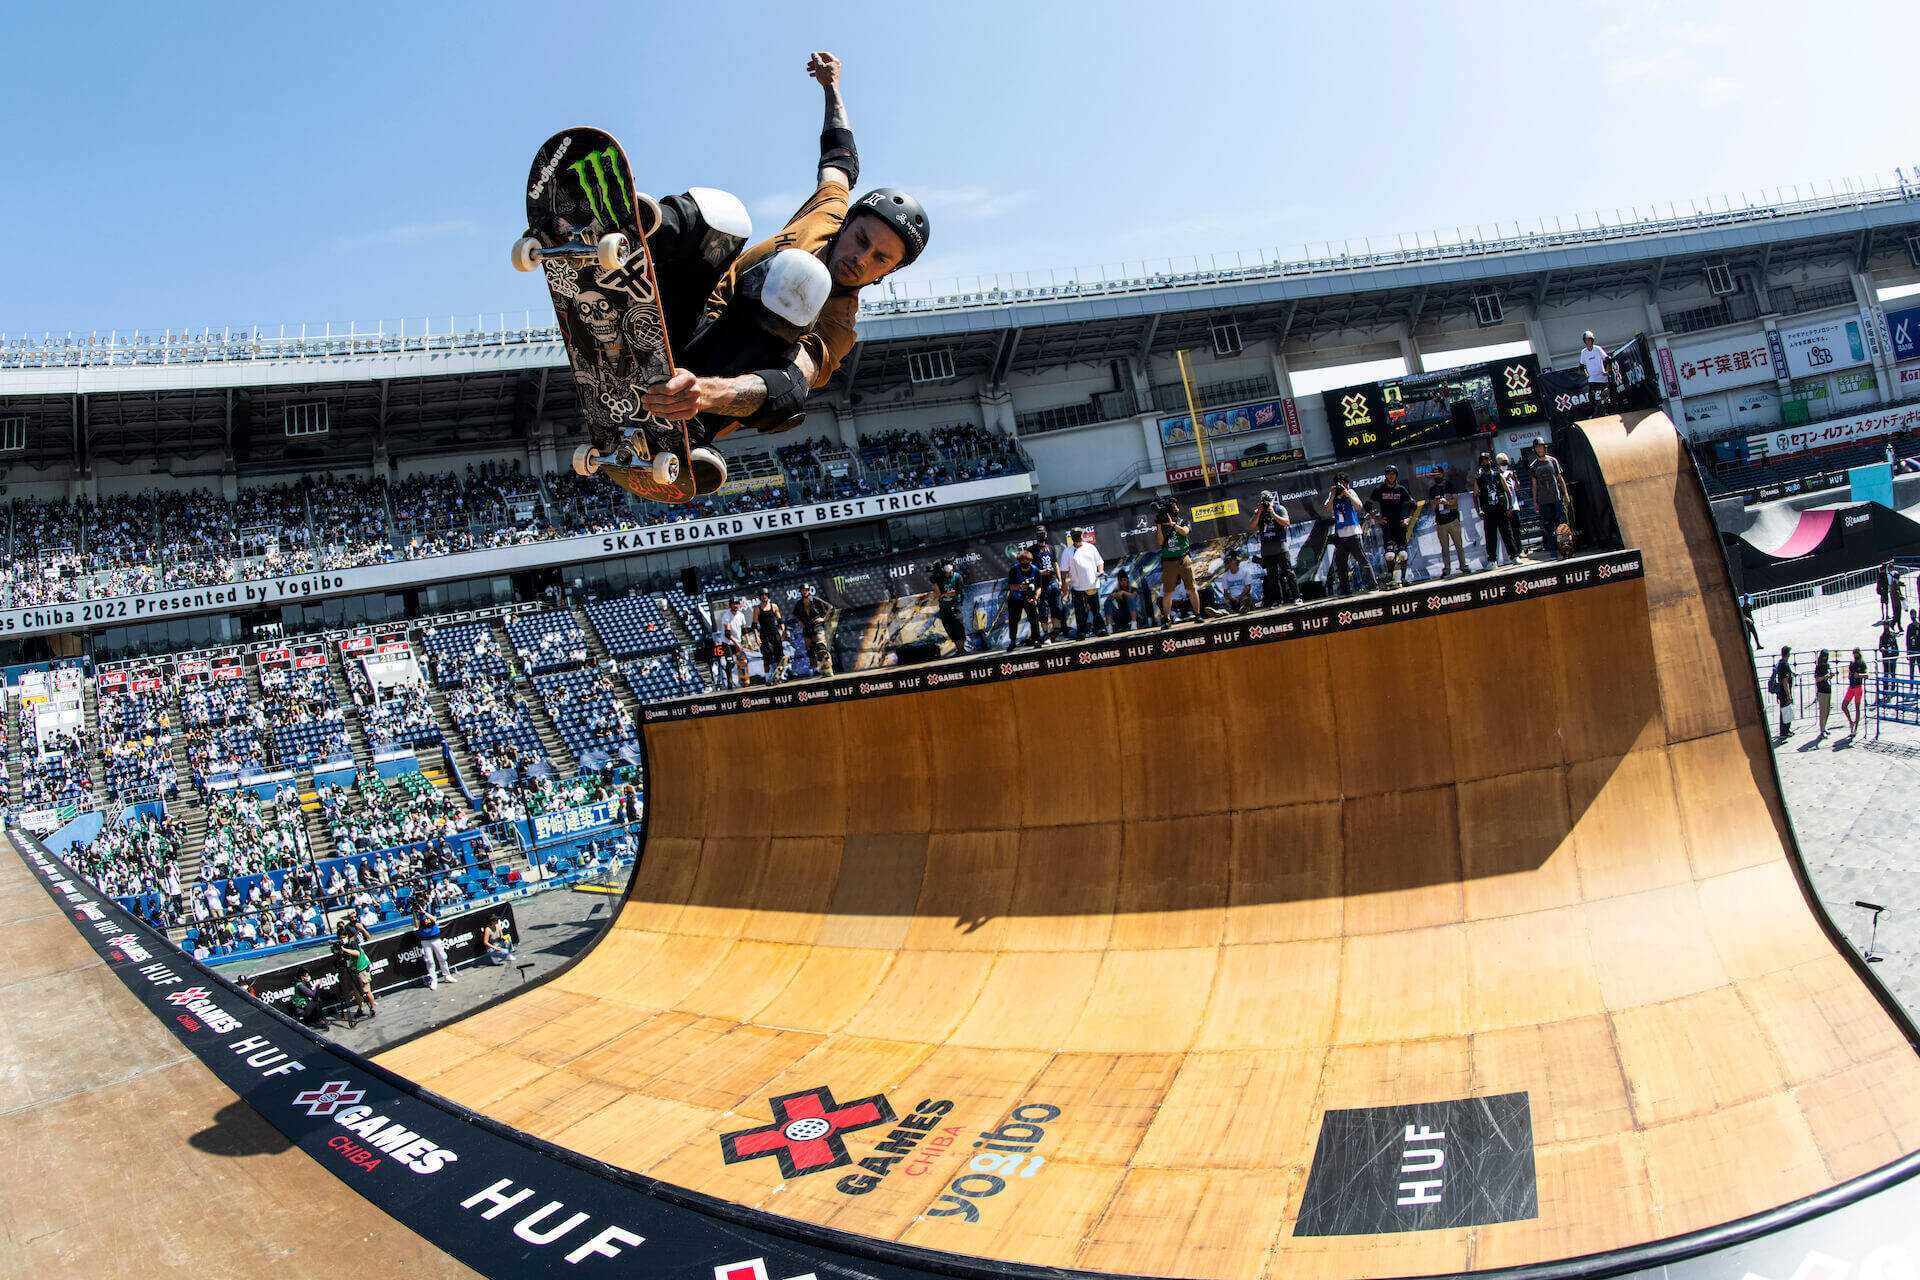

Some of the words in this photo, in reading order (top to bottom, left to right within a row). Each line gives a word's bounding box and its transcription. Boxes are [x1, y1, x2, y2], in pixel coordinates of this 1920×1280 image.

[528, 136, 572, 200] birdhouse
[1696, 347, 1769, 377] 千葉銀行
[1507, 386, 1533, 398] GAMES
[1345, 416, 1372, 427] GAMES
[1281, 488, 1318, 501] KODANSHA
[1829, 475, 1844, 484] HUF
[603, 520, 743, 551] SKATEBOARD
[754, 511, 805, 530] VERT
[816, 501, 866, 520] BEST
[875, 490, 937, 512] TRICK
[890, 564, 915, 578] HUF
[23, 609, 74, 627] Chiba
[82, 601, 127, 621] 2022
[135, 588, 237, 614] Presented
[246, 584, 267, 601] by
[275, 575, 344, 596] Yogibo
[380, 653, 396, 663] 212
[653, 709, 668, 717] GAMES
[672, 707, 687, 715] HUF
[699, 704, 717, 712] GAMES
[721, 701, 737, 711] HUF
[750, 697, 770, 706] GAMES
[775, 694, 793, 704] HUF
[807, 689, 829, 699] GAMES
[834, 686, 854, 697] HUF
[869, 681, 893, 692] GAMES
[899, 678, 921, 689] HUF
[938, 672, 964, 683] GAMES
[970, 667, 993, 679] HUF
[1012, 660, 1040, 672] GAMES
[1047, 656, 1071, 669] HUF
[1091, 649, 1120, 662] GAMES
[1128, 644, 1154, 657] HUF
[1175, 636, 1206, 649] GAMES
[1213, 630, 1241, 644] HUF
[1262, 622, 1294, 635] GAMES
[1302, 617, 1329, 631] HUF
[1352, 607, 1383, 621] GAMES
[1391, 602, 1419, 616] HUF
[1441, 592, 1472, 606] GAMES
[1479, 586, 1506, 601] HUF
[1528, 576, 1558, 590] GAMES
[1565, 570, 1591, 585] HUF
[1610, 560, 1639, 574] GAMES
[93, 919, 123, 935] HUF
[449, 931, 473, 946] GAMES
[119, 941, 152, 963] GAMES
[139, 962, 183, 986] HUF
[176, 1013, 202, 1033] CHIBA
[186, 999, 243, 1034] GAMES
[228, 1035, 306, 1077] HUF
[836, 1098, 955, 1195] GAMES
[904, 1125, 967, 1177] CHIBA
[926, 1103, 1061, 1224] yogibo
[1397, 1124, 1445, 1206] HUF
[333, 1104, 458, 1175] GAMES
[459, 1177, 647, 1264] HUF
